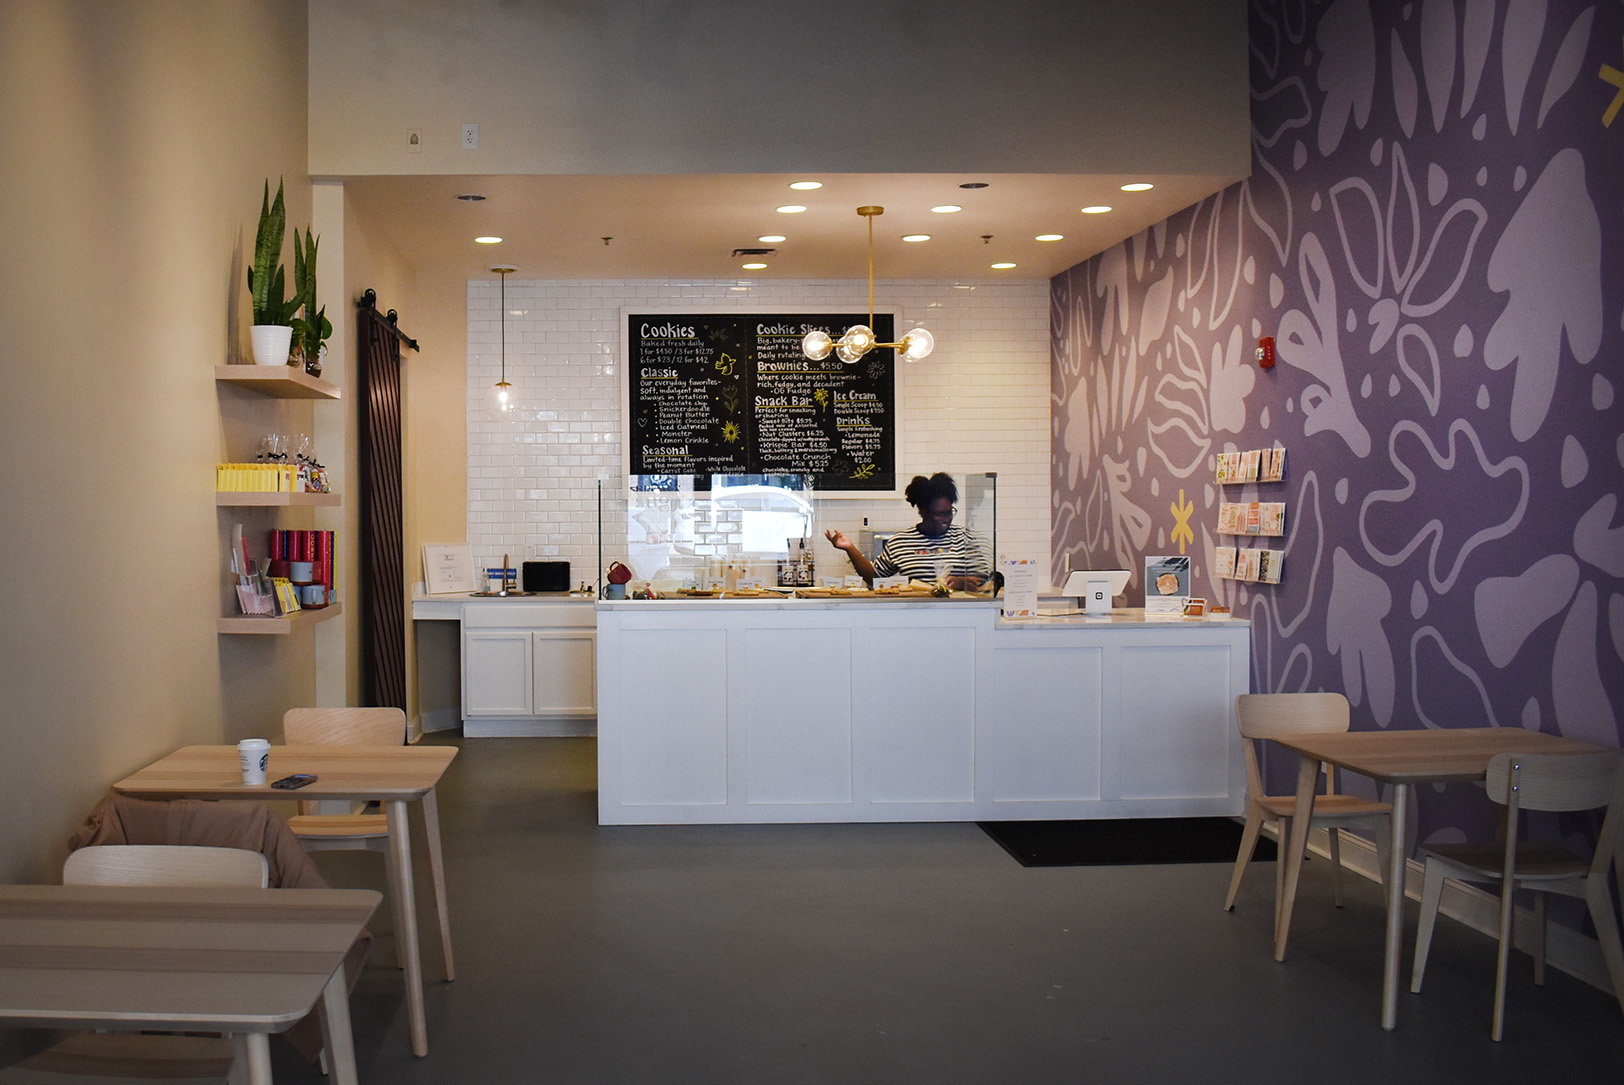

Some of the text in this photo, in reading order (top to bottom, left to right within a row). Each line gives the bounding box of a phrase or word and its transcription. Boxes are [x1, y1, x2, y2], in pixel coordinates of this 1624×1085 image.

[640, 322, 696, 338] Cookies
[756, 323, 796, 335] Cookie
[640, 356, 645, 364] 6
[758, 351, 806, 360] Daily rotating
[820, 362, 843, 371] $5.50
[641, 366, 678, 377] Classic
[655, 379, 687, 388] everyday
[660, 387, 690, 395] indulgent
[787, 388, 812, 396] Fudge
[833, 390, 877, 400] Ice Cream
[755, 395, 813, 406] Snack Bar
[836, 415, 871, 424] Drinks
[642, 445, 689, 455] Seasonal
[708, 455, 733, 465] inspired
